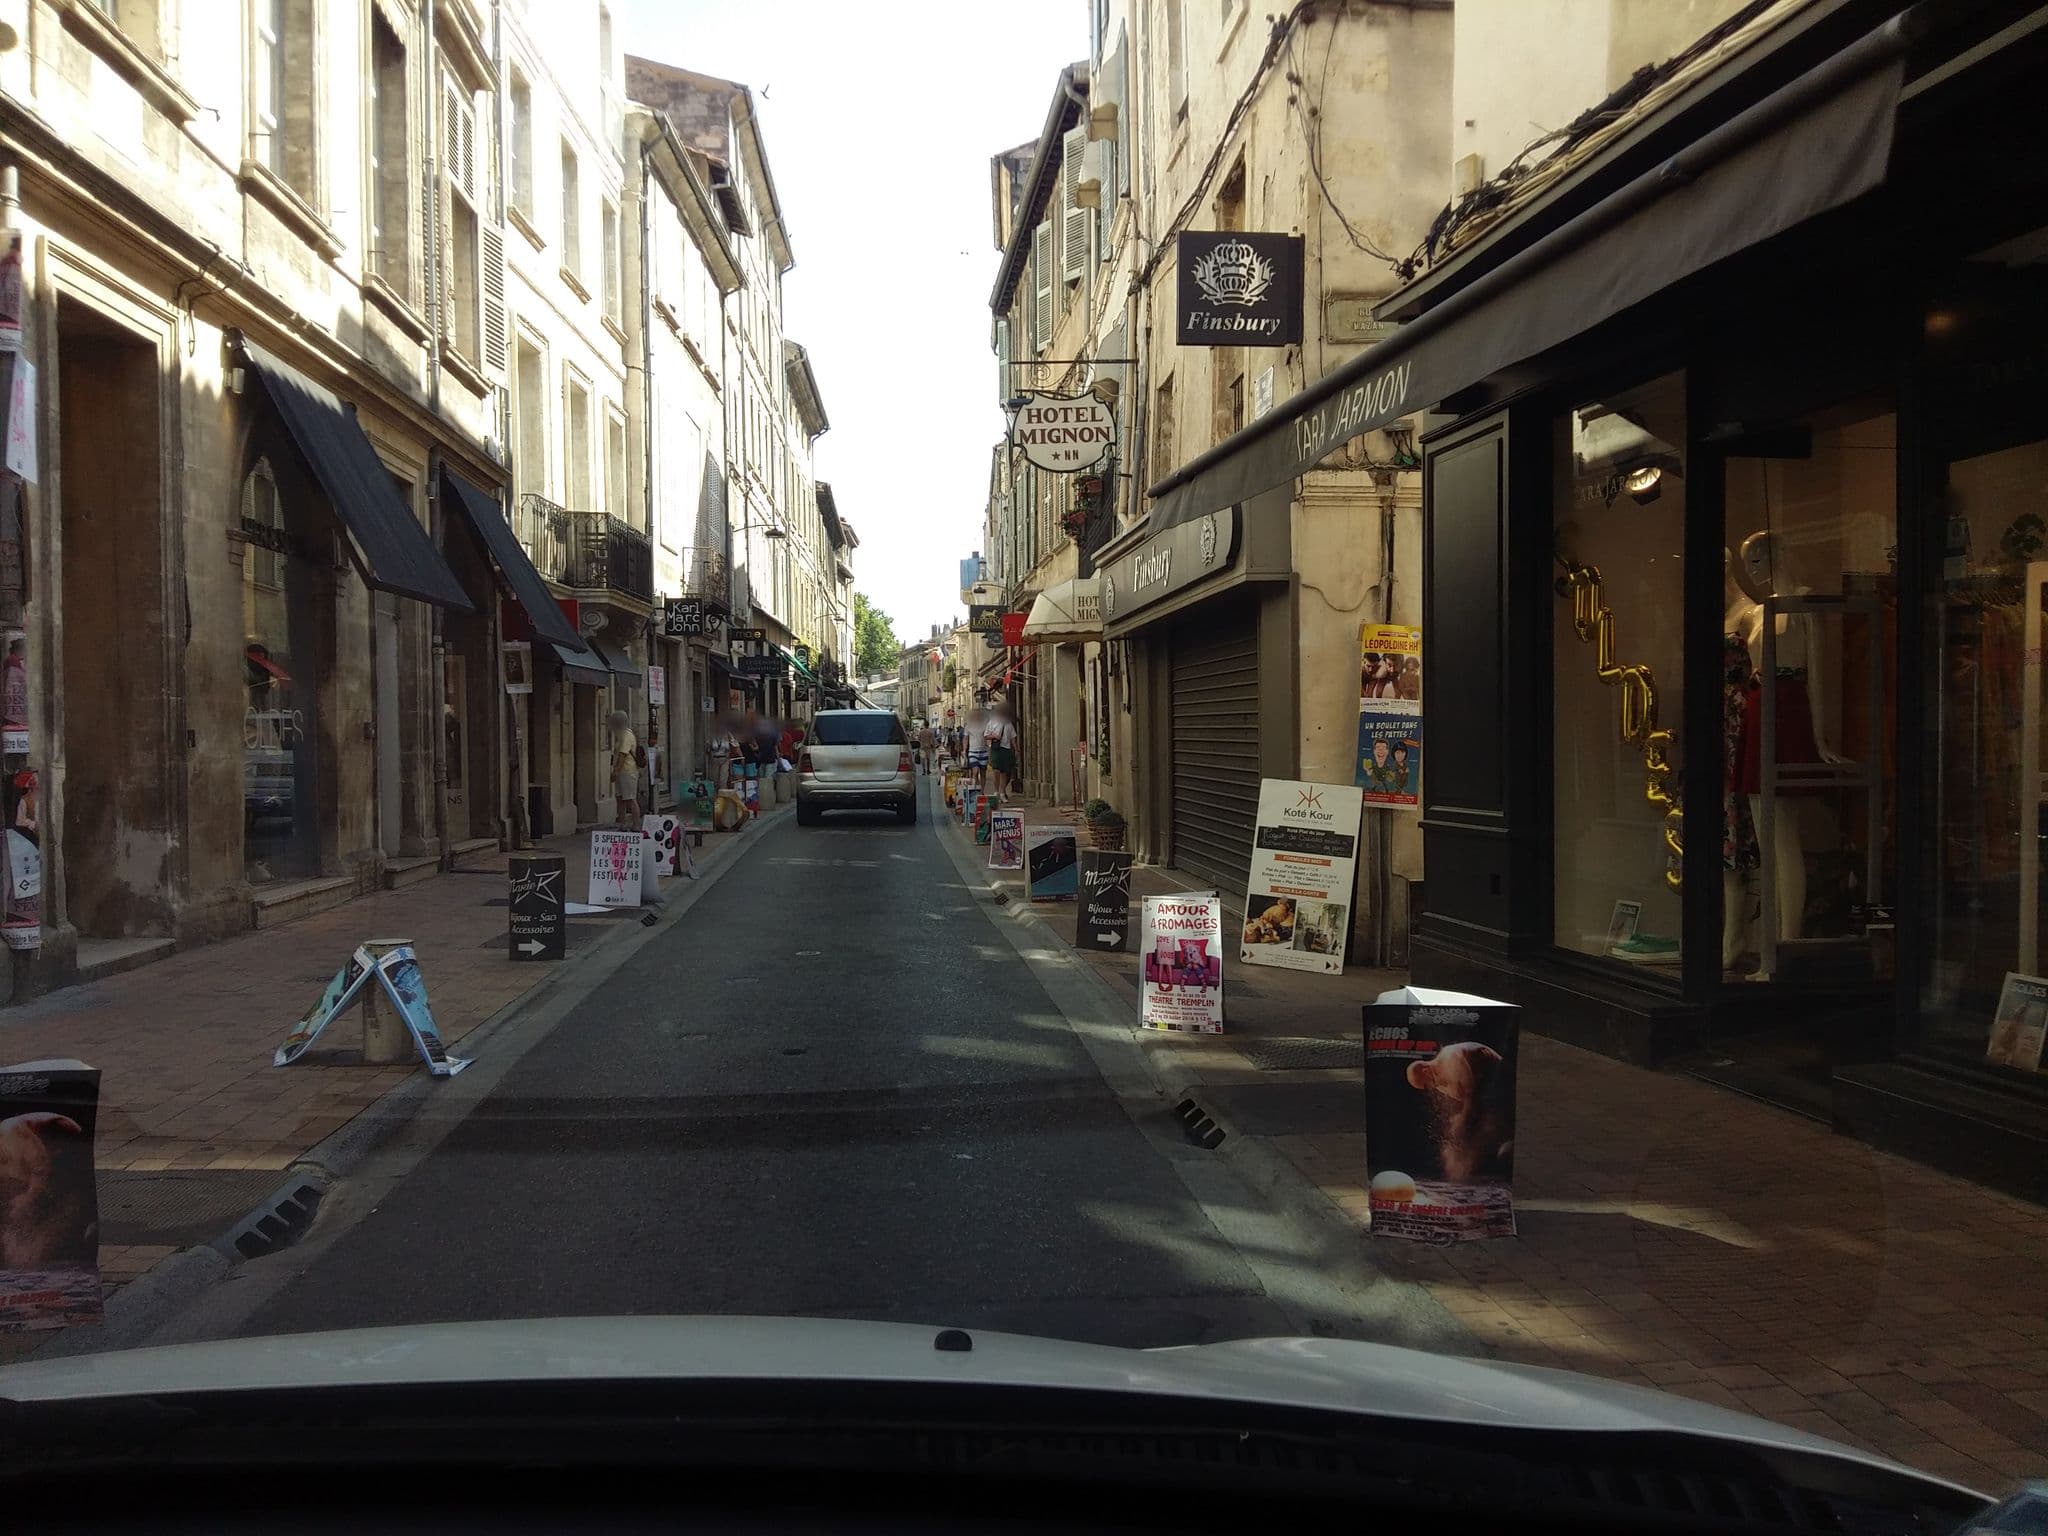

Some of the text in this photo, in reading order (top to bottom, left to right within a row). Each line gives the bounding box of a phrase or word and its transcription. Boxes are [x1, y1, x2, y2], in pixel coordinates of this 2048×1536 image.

[1186, 311, 1281, 336] Finsbury
[1025, 406, 1104, 426] HOTEL
[1293, 409, 1327, 463] TARA
[1330, 361, 1412, 441] JARMON
[1018, 425, 1111, 446] MIGNON
[1133, 545, 1174, 593] Finsbury
[672, 601, 701, 614] Karl
[667, 610, 701, 624] Marc
[667, 621, 701, 633] John
[1284, 806, 1334, 821] Koté Kour
[994, 818, 1016, 830] MARS
[594, 834, 640, 844] 9 SPECTACLES
[594, 847, 640, 857] VIVANTS
[594, 859, 640, 869] LES DOMS
[593, 870, 628, 881] FESTIVAL
[511, 878, 536, 894] arie
[1157, 903, 1210, 916] AMOUR
[511, 912, 532, 923] ijoux
[1158, 918, 1218, 930] FROMAGES
[1177, 998, 1215, 1007] TREMPLIN
